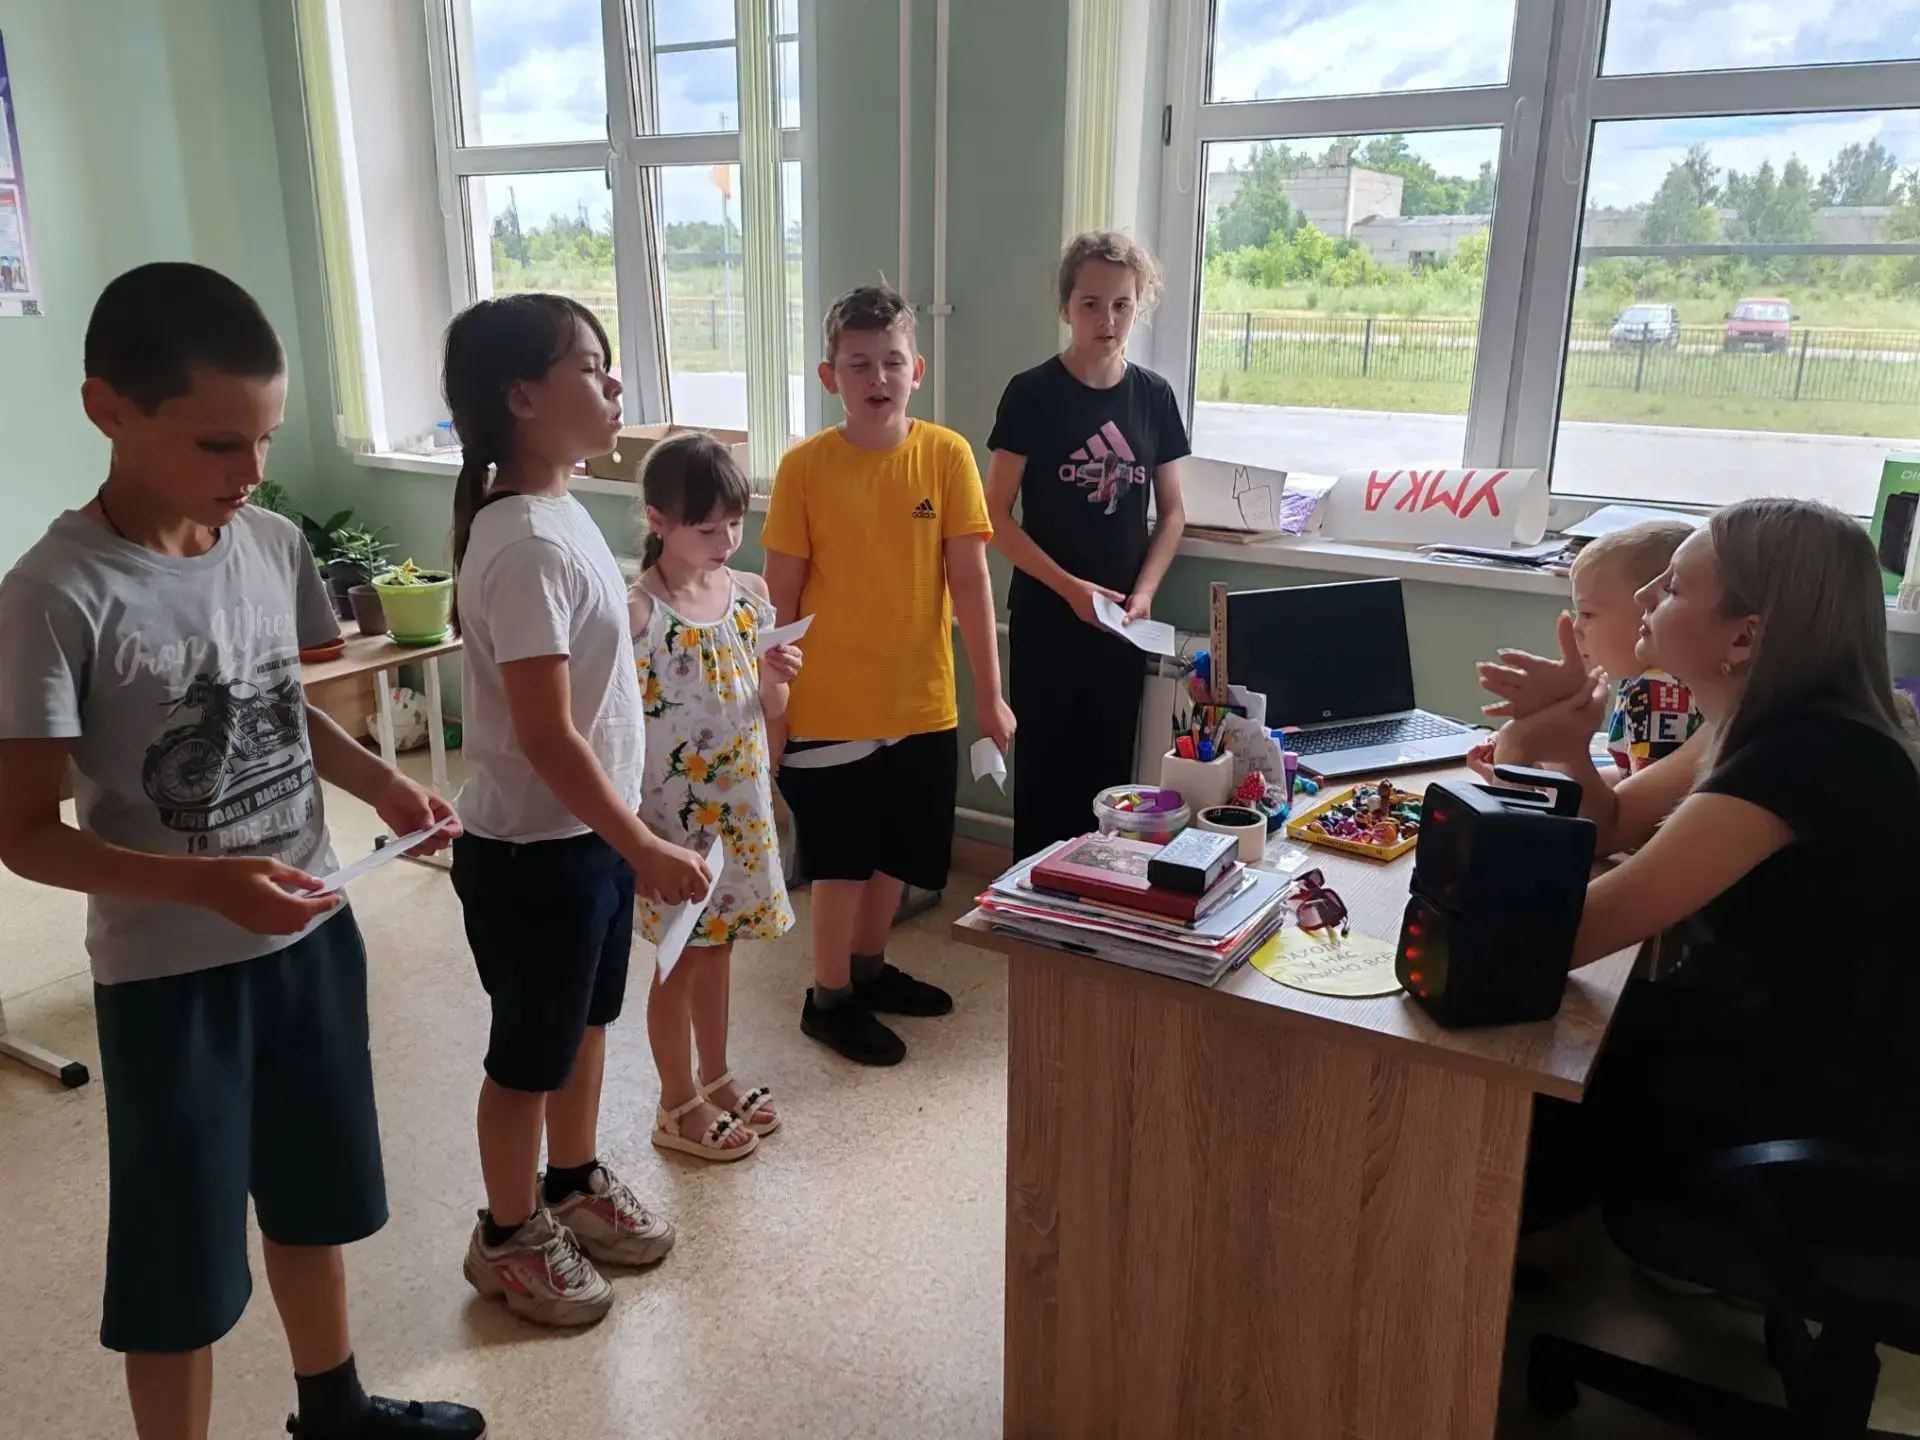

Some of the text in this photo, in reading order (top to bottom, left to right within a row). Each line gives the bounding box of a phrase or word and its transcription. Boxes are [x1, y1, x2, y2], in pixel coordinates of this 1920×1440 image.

[1365, 469, 1510, 519] УМКА
[912, 509, 937, 520] adidas
[255, 773, 300, 807] RACERS
